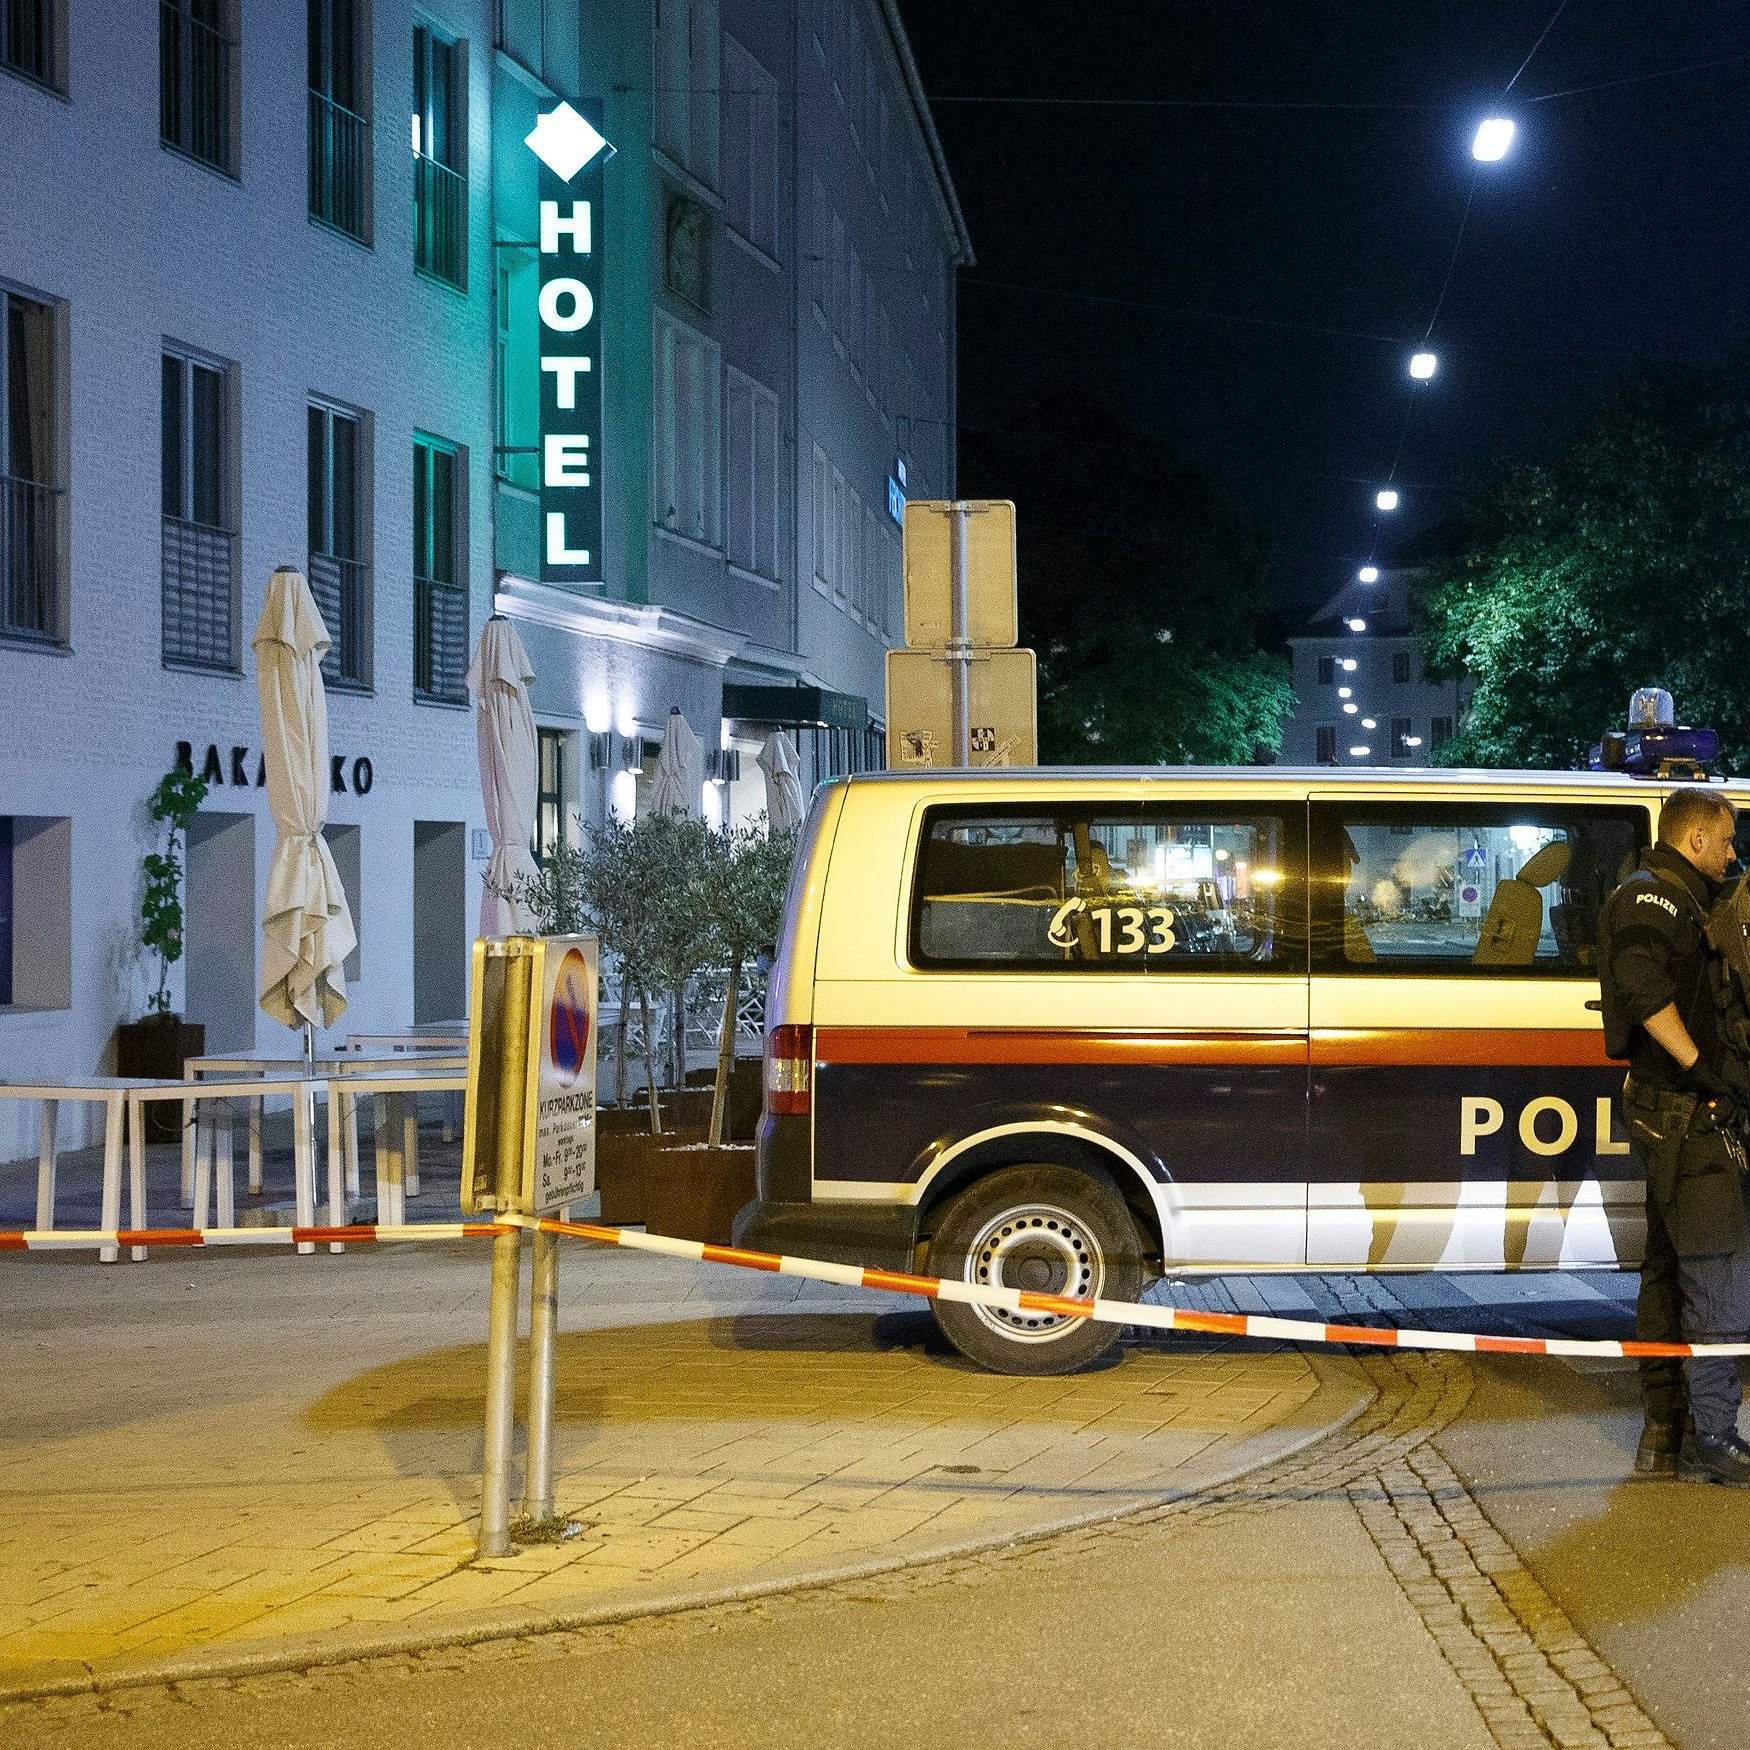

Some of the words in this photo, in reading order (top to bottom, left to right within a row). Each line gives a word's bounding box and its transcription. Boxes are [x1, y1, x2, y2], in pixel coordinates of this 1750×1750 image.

[538, 200, 595, 566] HOTEL
[1636, 893, 1678, 918] POLIZEI
[1091, 907, 1176, 954] 133
[539, 1090, 593, 1120] KURZPARKZONE
